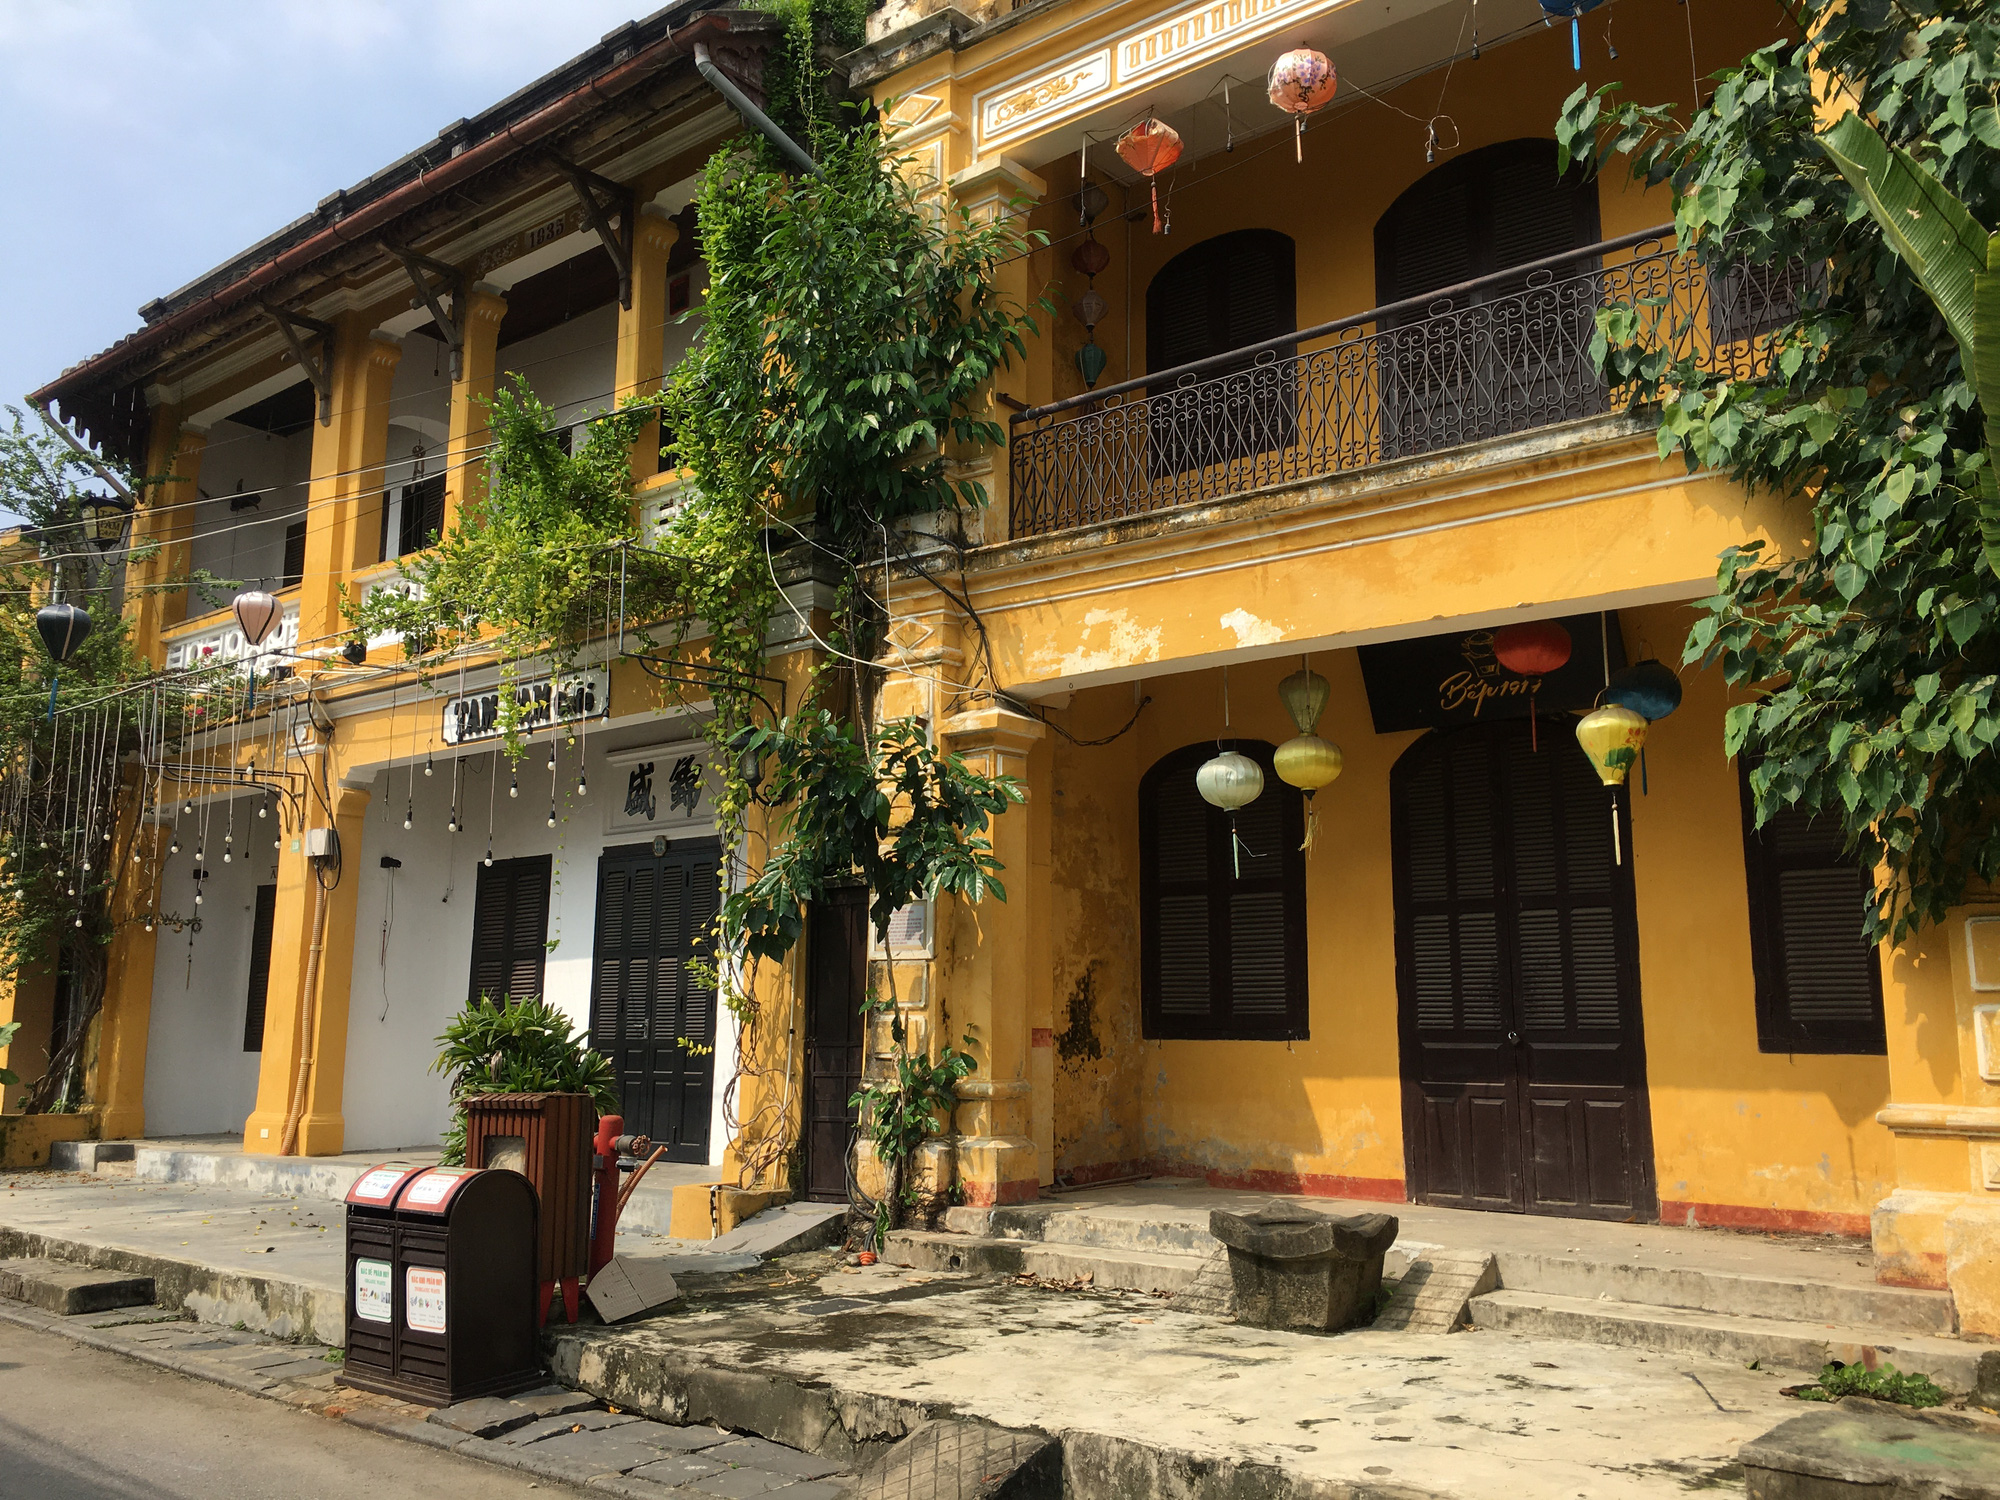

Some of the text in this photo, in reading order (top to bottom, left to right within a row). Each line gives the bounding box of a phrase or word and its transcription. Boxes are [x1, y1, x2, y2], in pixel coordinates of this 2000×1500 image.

[530, 218, 564, 248] 1935
[454, 694, 498, 741] TAM
[508, 682, 551, 728] AM
